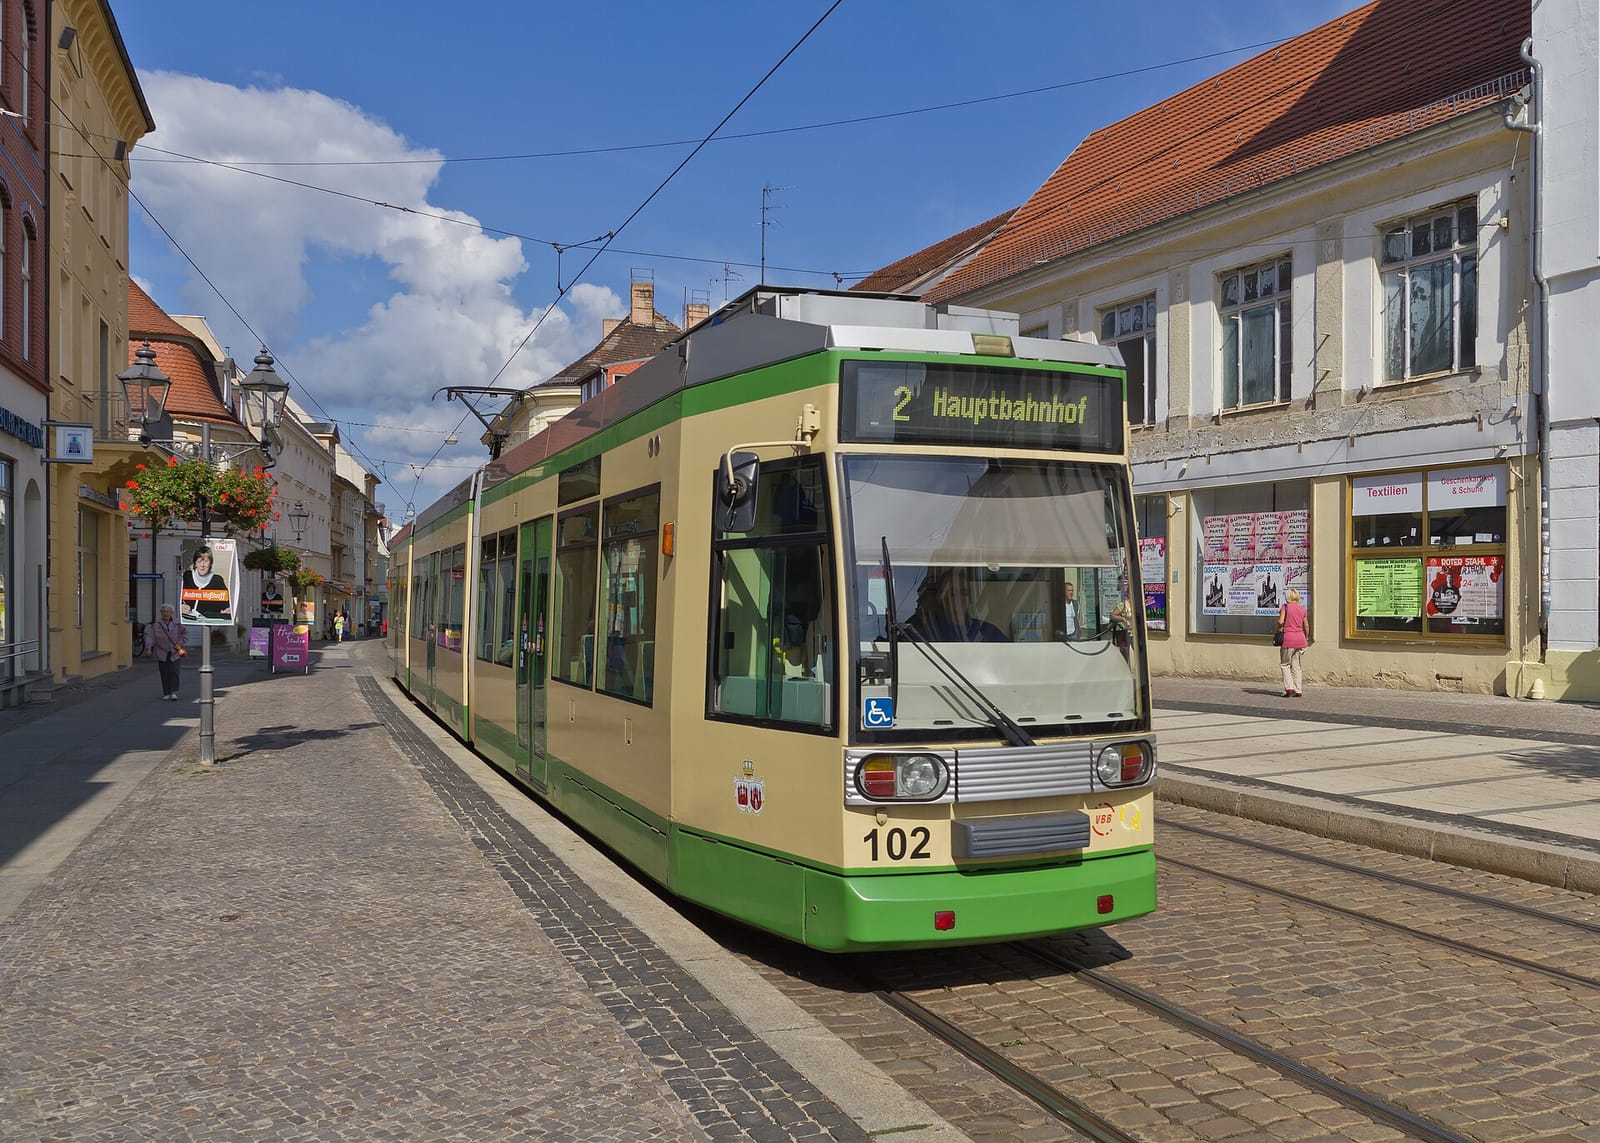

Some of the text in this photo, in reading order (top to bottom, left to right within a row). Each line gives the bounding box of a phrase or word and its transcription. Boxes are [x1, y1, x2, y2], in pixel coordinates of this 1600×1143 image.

[892, 386, 1088, 425] 2 Hauptbahnhof
[1440, 473, 1494, 485] Geschenkartikel
[1366, 485, 1408, 498] Textilien
[1451, 485, 1484, 495] & Schuhe
[1256, 513, 1283, 521] SUMMER
[1283, 512, 1310, 520] SUMMER
[1441, 557, 1486, 567] ROTER STAHL
[1256, 565, 1282, 573] DISCOTHEK
[1095, 813, 1113, 825] VBB
[863, 827, 931, 862] 102
